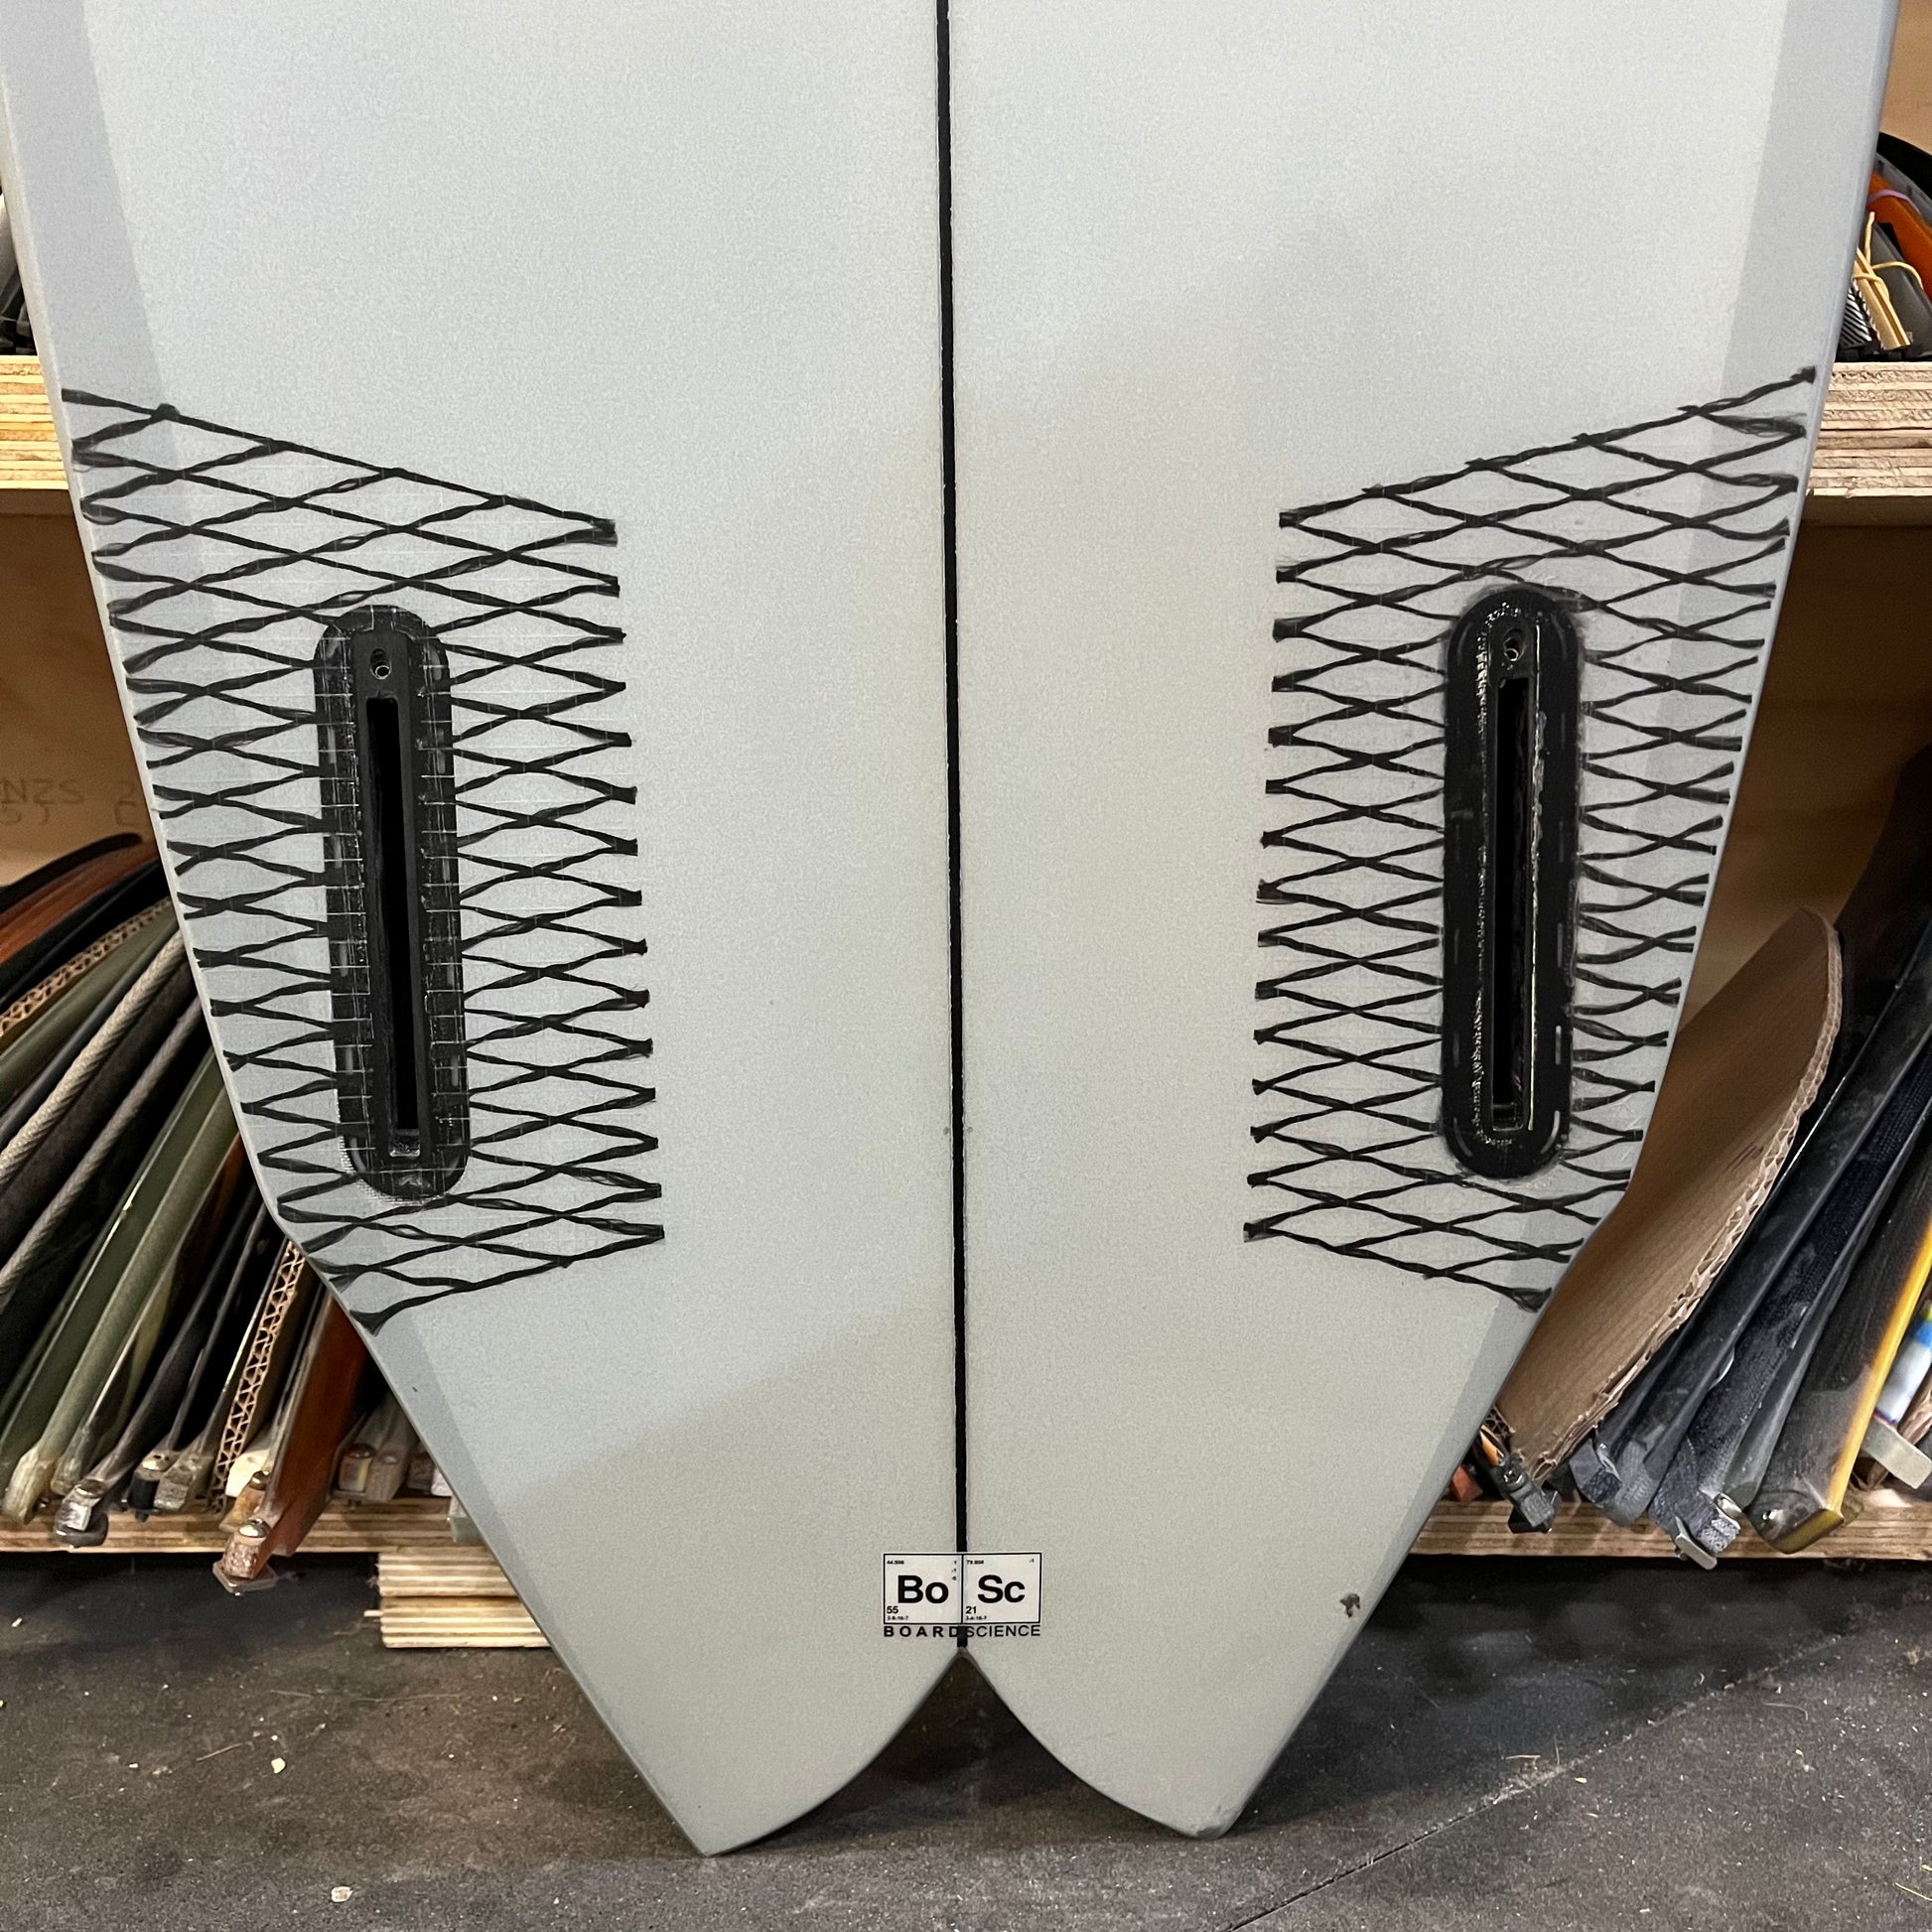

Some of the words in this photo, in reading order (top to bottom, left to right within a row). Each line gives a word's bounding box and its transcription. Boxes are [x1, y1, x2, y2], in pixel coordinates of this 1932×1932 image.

[897, 1575, 949, 1604] Bo
[977, 1575, 1026, 1604] Sc
[887, 1605, 898, 1614] 55
[965, 1605, 977, 1614] 21
[884, 1625, 959, 1638] BOARD
[966, 1624, 1040, 1638] SCIENCE
